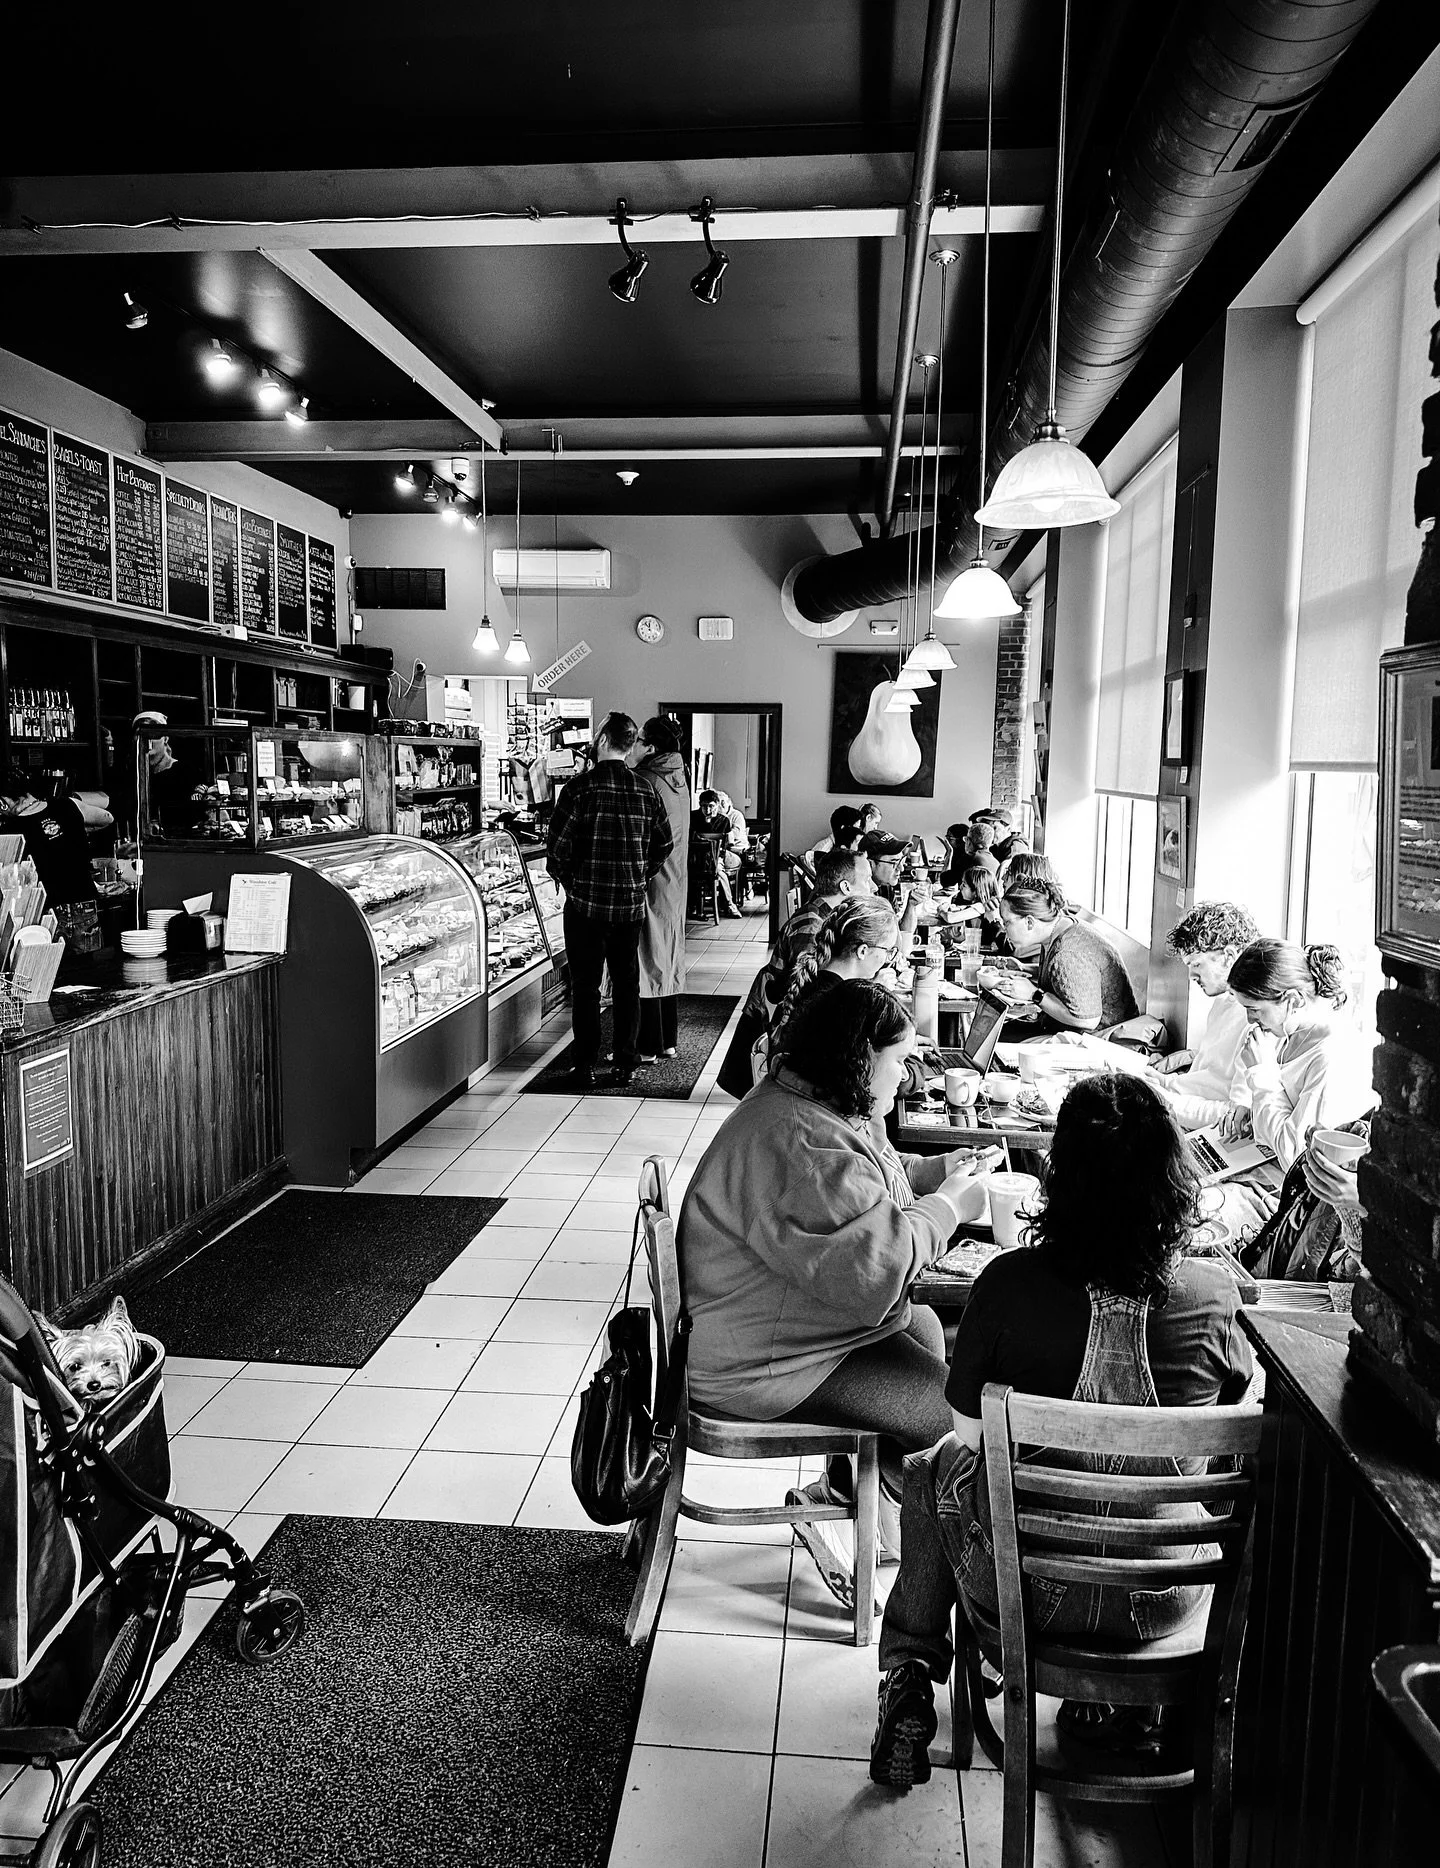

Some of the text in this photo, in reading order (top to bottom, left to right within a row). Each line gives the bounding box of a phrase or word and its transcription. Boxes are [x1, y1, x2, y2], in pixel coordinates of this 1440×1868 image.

[8, 422, 47, 454] SANDWICHES
[81, 454, 103, 476] TOAST
[537, 645, 588, 688] ORDER HERE
